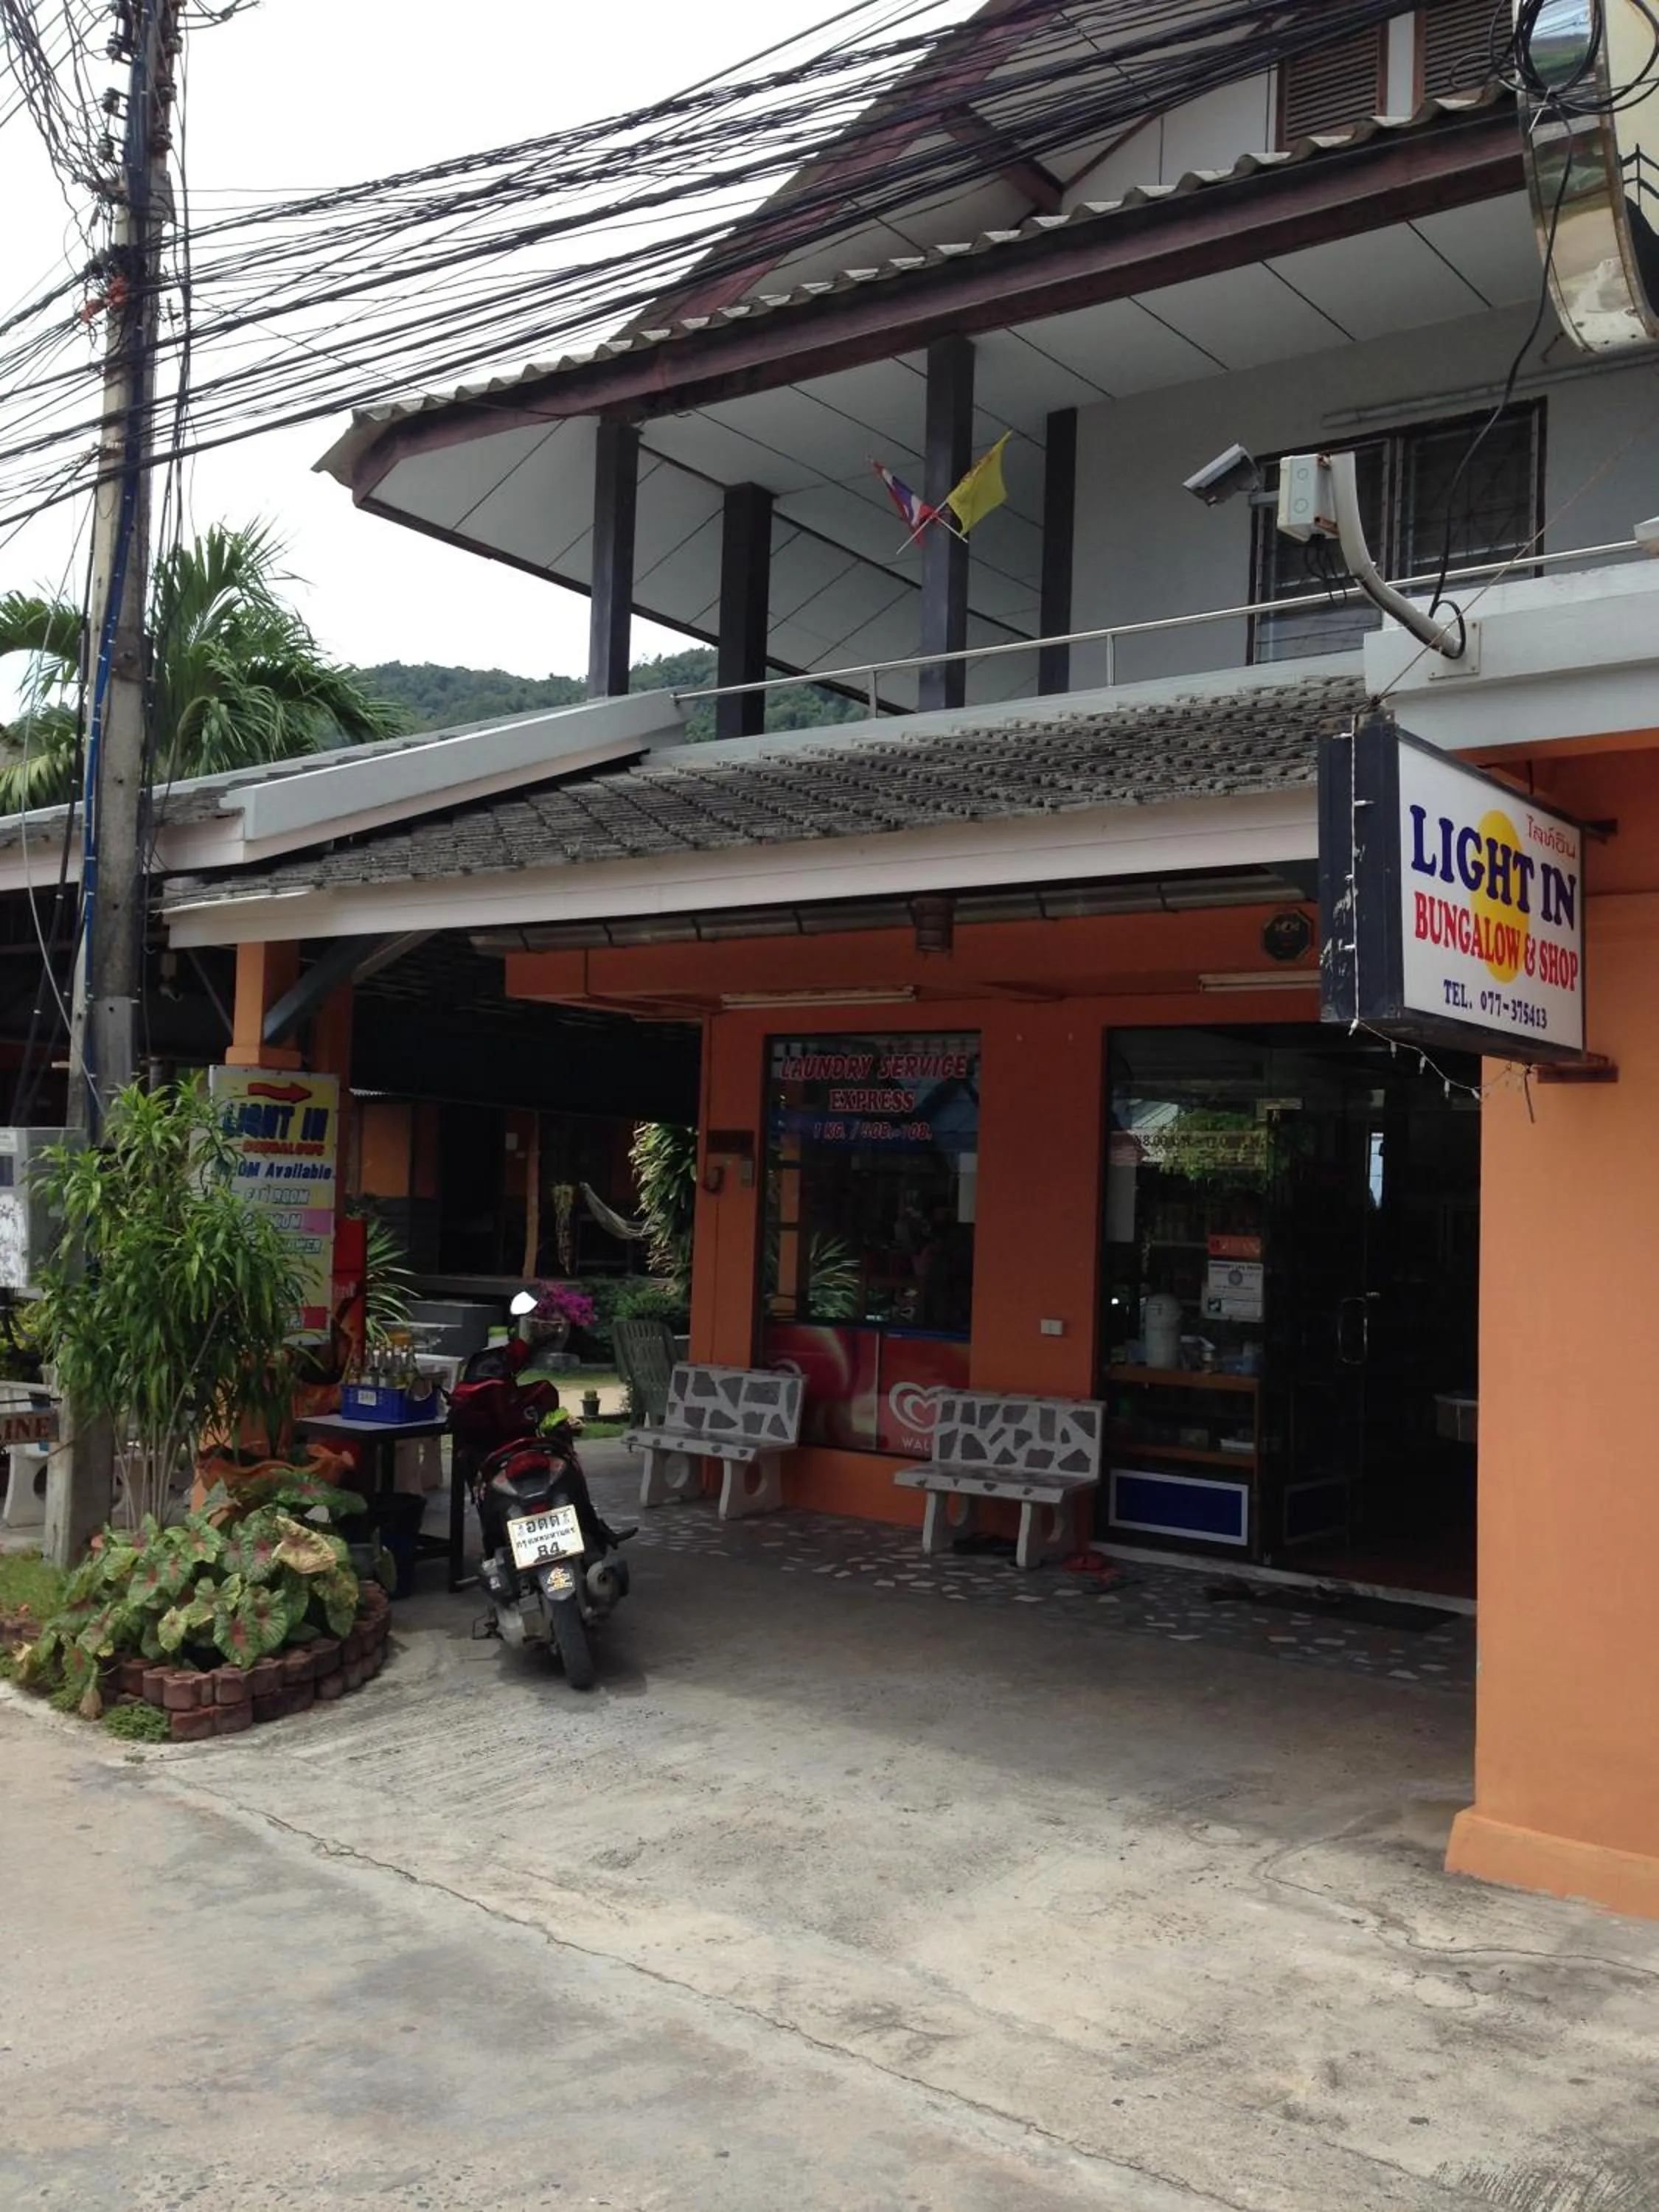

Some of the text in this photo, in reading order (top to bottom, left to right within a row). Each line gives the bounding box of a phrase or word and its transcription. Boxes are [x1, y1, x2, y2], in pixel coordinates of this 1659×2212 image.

[1409, 804, 1577, 931] LIGHT IN
[1414, 891, 1579, 992] BUNGALOW & SHOP
[1443, 979, 1548, 1029] TEL. 077-375413
[780, 1050, 969, 1081] LAUNDRY SERVICE
[829, 1088, 916, 1113] EXPRESS
[265, 1161, 333, 1180] Available
[0, 1416, 50, 1441] INE
[900, 1436, 933, 1453] WAL
